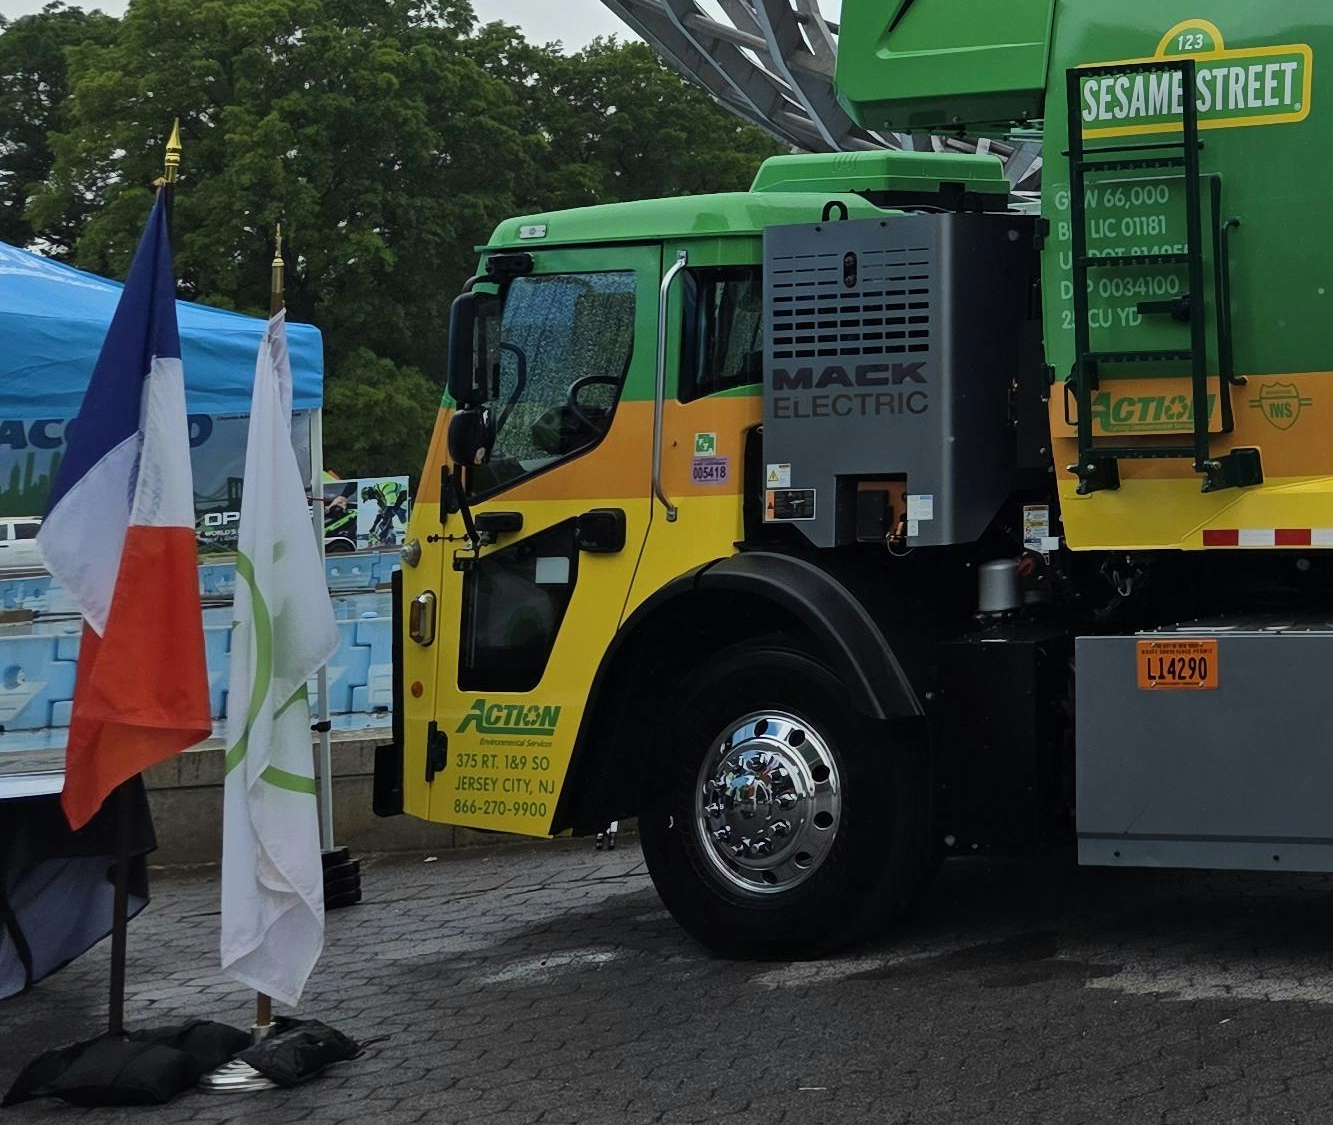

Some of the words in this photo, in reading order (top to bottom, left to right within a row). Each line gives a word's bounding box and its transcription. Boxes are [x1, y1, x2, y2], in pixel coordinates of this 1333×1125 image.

[1177, 34, 1203, 51] 123
[1082, 71, 1183, 122] SESAME
[1196, 62, 1297, 111] STREET
[1055, 188, 1098, 211] GW
[1104, 185, 1169, 209] 66,000
[1091, 218, 1117, 238] LIC
[1121, 215, 1166, 236] 01181
[1100, 275, 1179, 297] 0034100
[1088, 309, 1112, 328] CU
[772, 362, 928, 391] MACK
[773, 391, 929, 419] ELECTRIC
[1269, 401, 1293, 418] IWS
[692, 466, 726, 480] 005418
[1147, 656, 1207, 680] L14290
[456, 753, 478, 769] 375
[481, 754, 499, 770] RT.
[504, 755, 527, 771] 1&9
[532, 756, 550, 772] SO
[454, 776, 498, 792] JERSEY
[502, 777, 533, 796] CITY,
[538, 779, 555, 794] NJ
[454, 799, 547, 817] 866-270-9900
